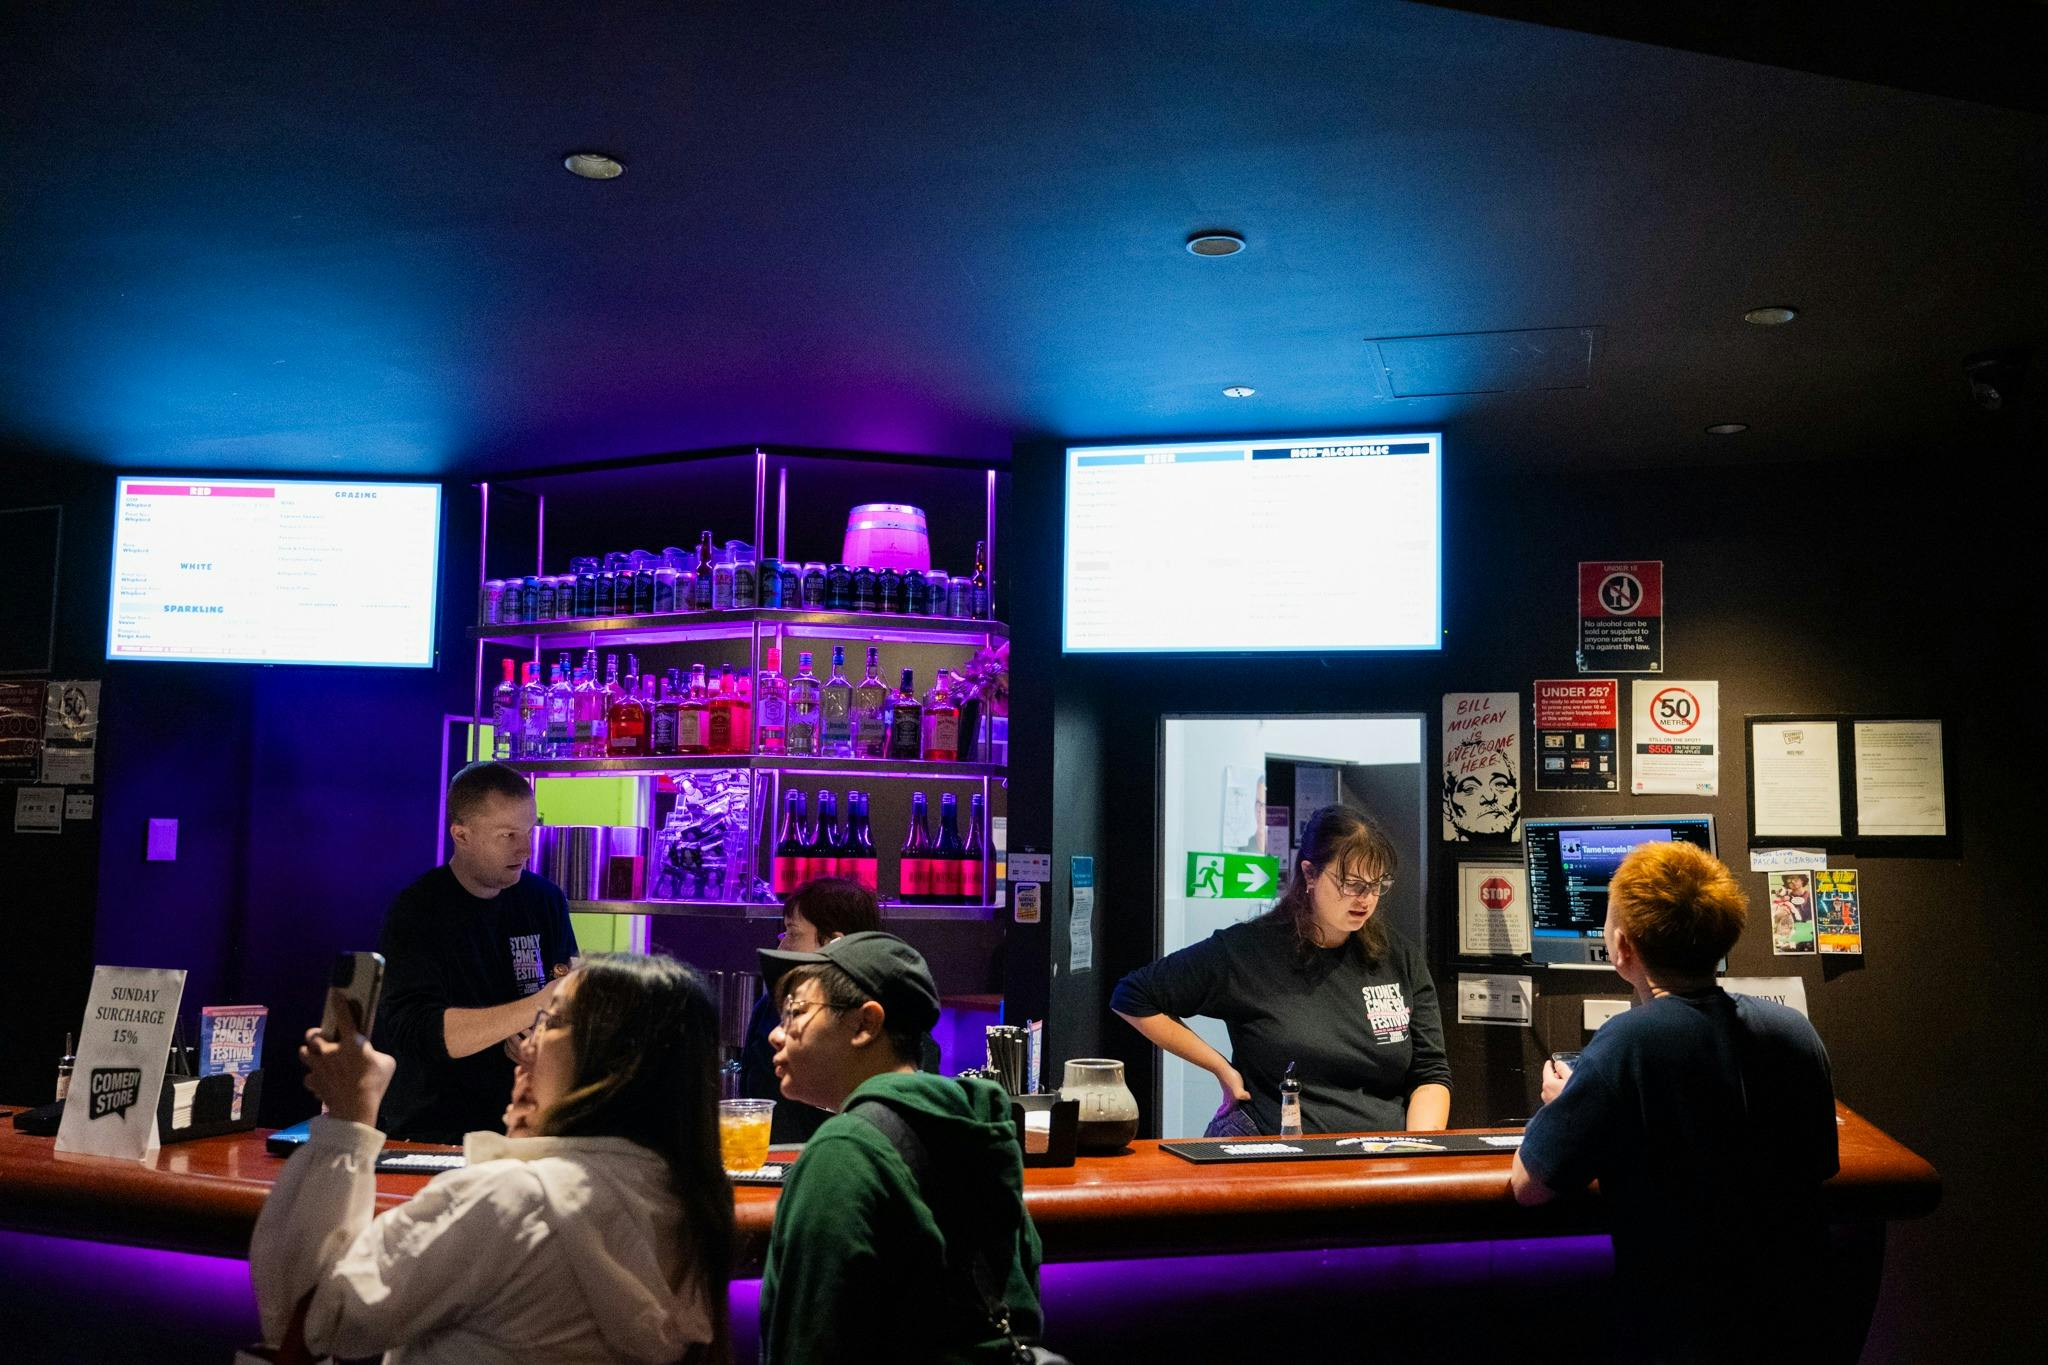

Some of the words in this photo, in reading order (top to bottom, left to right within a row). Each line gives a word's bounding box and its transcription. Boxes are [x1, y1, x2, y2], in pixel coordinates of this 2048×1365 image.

[1290, 445, 1390, 458] NON-ALCOHOLIC
[189, 486, 212, 496] RED
[334, 491, 378, 499] GRAZING
[180, 562, 213, 571] WHITE
[163, 604, 225, 614] SPARKLING
[1610, 628, 1640, 637] supplied
[1611, 635, 1633, 643] under
[1596, 643, 1622, 651] against
[1542, 687, 1586, 697] UNDER
[1588, 687, 1610, 697] 25?
[1456, 698, 1491, 715] BILL
[1660, 698, 1691, 718] 50
[1447, 710, 1507, 733] MURRAY
[1446, 733, 1516, 764] WELCOME
[1648, 745, 1673, 754] $550
[1460, 753, 1497, 774] HERE
[1582, 845, 1602, 854] Tame
[1602, 845, 1627, 855] Impala
[1482, 887, 1511, 900] STOP
[111, 986, 160, 1003] SUNDAY
[1362, 983, 1401, 1000] SYDNEY
[1365, 996, 1405, 1013] COMEDY
[95, 1006, 165, 1025] SURCHARGE
[1370, 1013, 1410, 1030] FESTIVAL
[213, 1016, 260, 1030] SYDNEY
[112, 1029, 138, 1045] 15%
[211, 1029, 257, 1043] COMEDY
[210, 1046, 254, 1061] FESTIVAL
[92, 1071, 141, 1095] COMEDY
[95, 1091, 135, 1114] STORE
